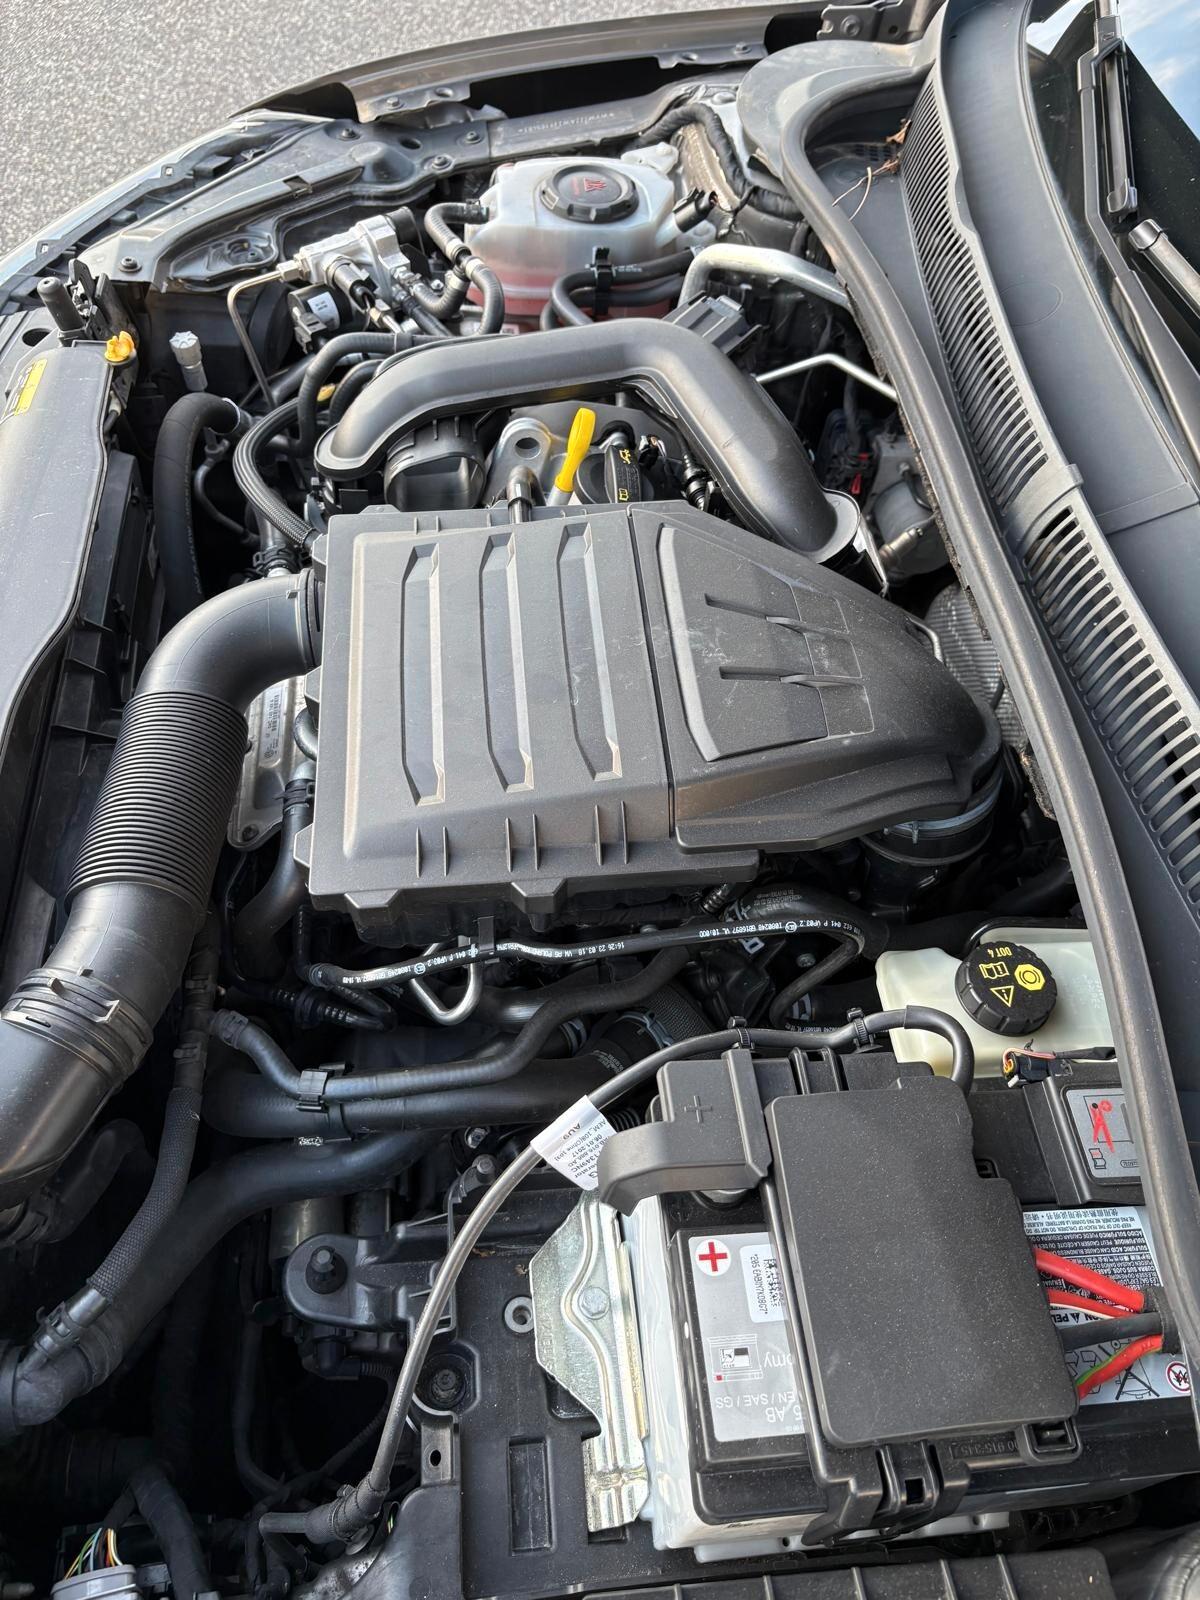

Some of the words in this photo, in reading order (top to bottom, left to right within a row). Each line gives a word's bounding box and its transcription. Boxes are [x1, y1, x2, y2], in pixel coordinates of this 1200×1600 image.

[987, 948, 994, 956] 4
[996, 946, 1012, 957] DOT
[764, 1351, 793, 1368] omy
[715, 1397, 733, 1409] GS
[743, 1393, 768, 1407] SAE
[765, 1406, 785, 1423] AB
